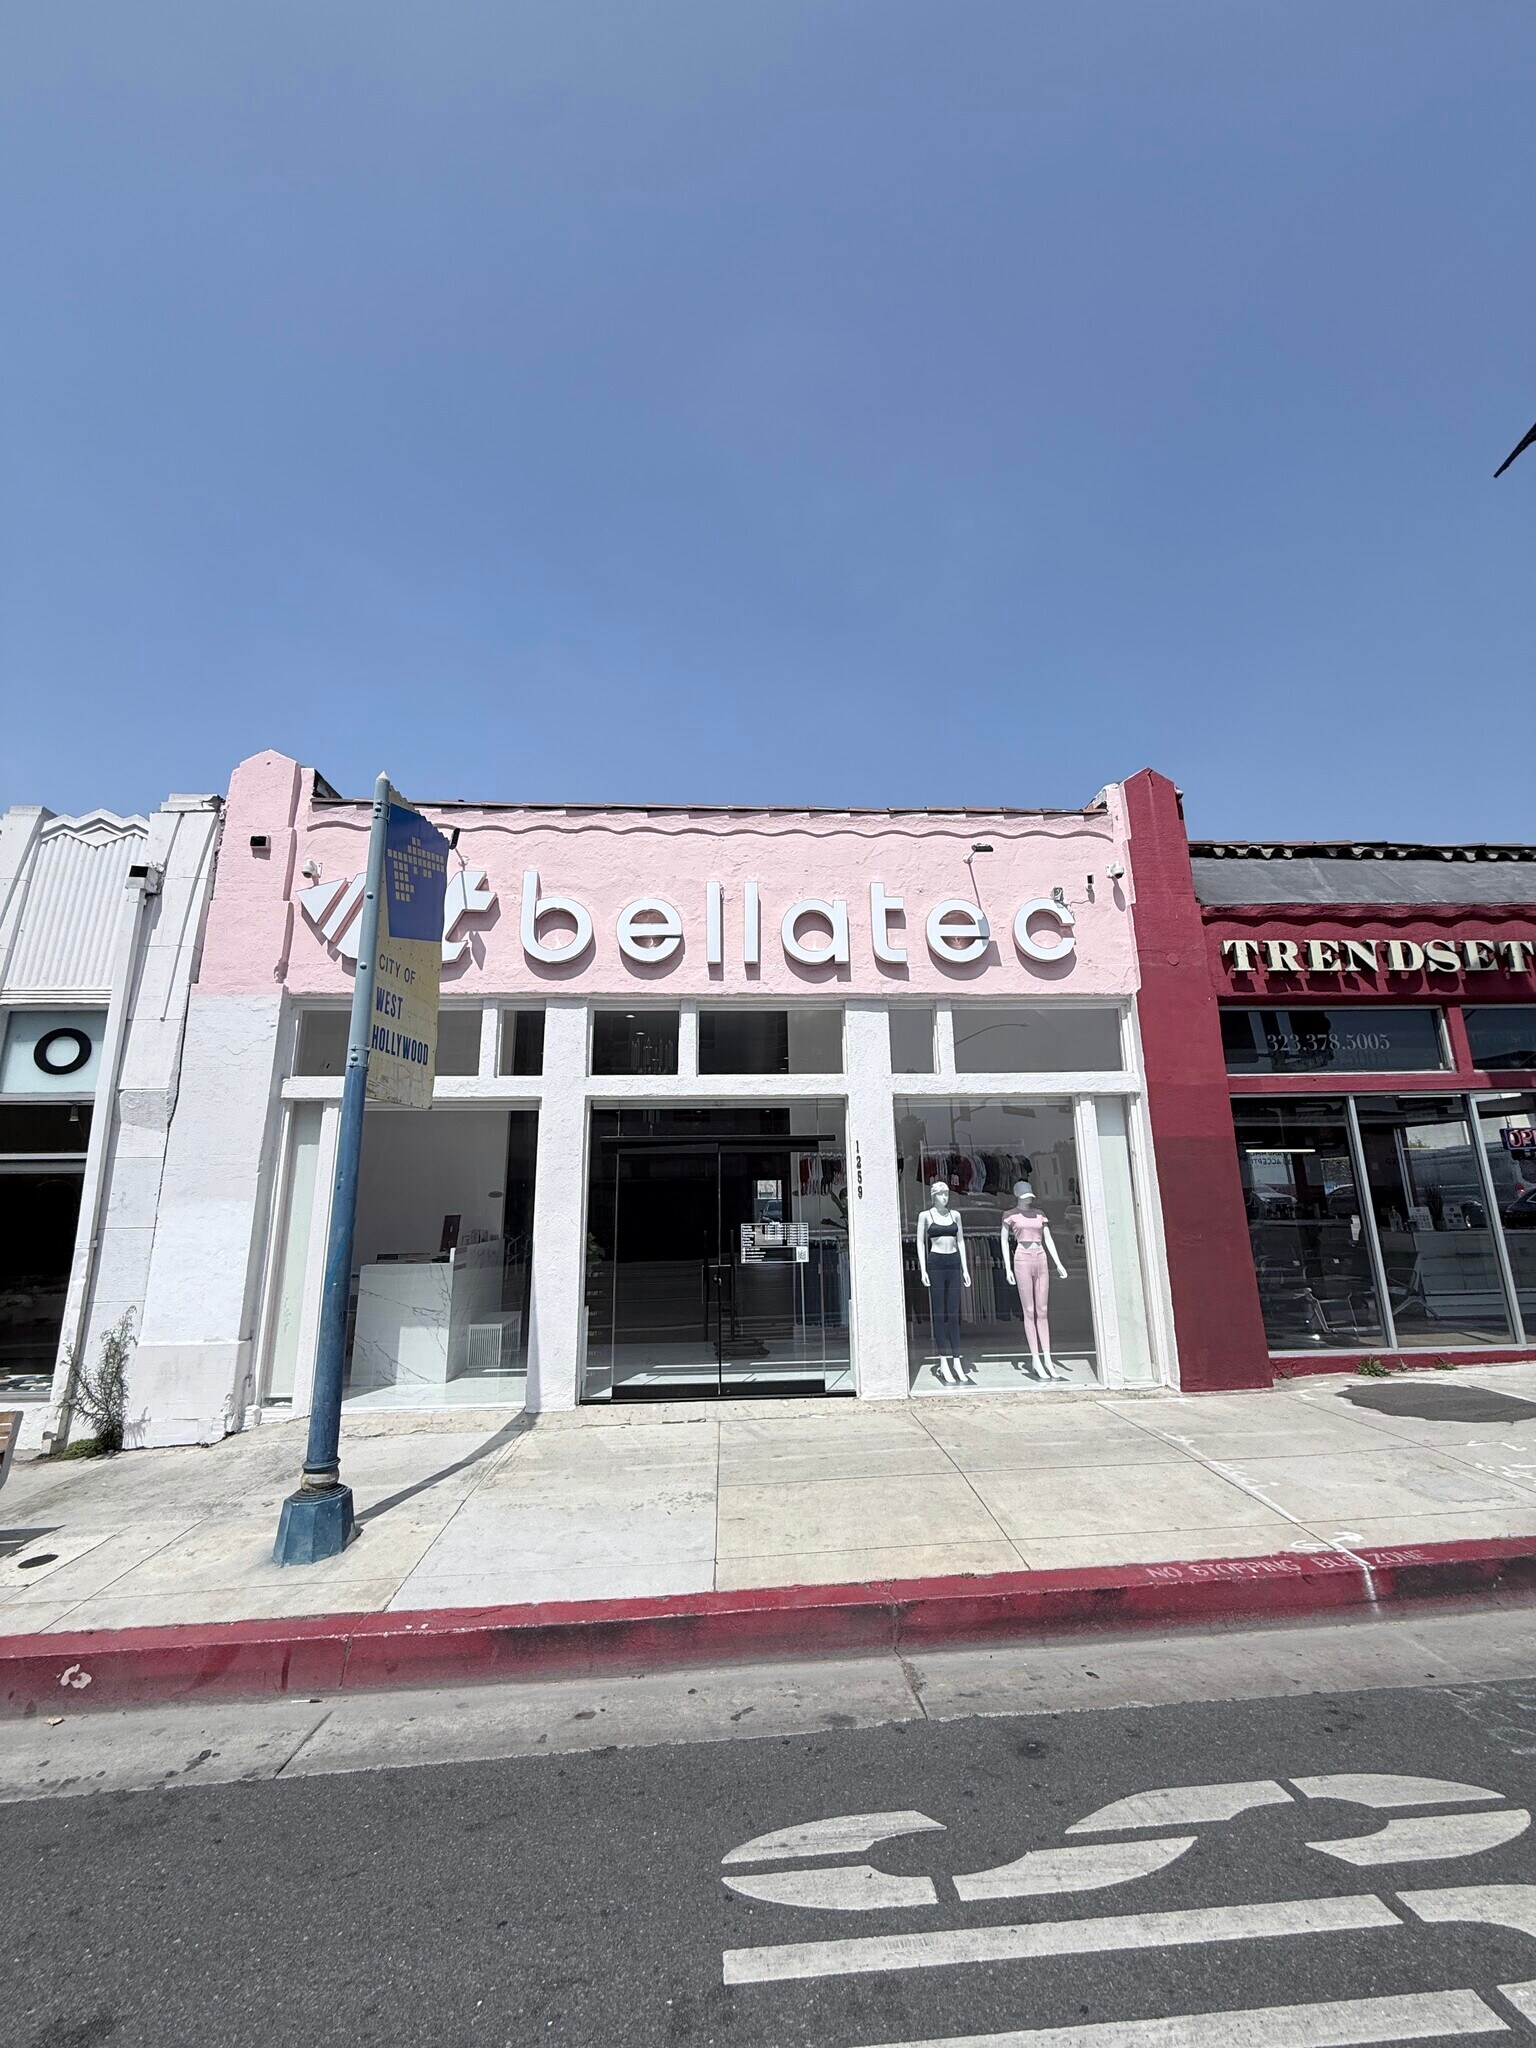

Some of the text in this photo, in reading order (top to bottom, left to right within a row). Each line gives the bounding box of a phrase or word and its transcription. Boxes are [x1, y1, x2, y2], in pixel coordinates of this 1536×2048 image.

[519, 869, 1077, 964] bellatec
[378, 953, 416, 985] CITY OF
[1222, 939, 1535, 973] TRENDSET
[376, 986, 403, 1020] WEST
[371, 1024, 429, 1066] HOLLYWOOD
[1267, 1033, 1390, 1051] 323.378.5005
[855, 1139, 863, 1200] 1259
[1146, 1549, 1433, 1579] NO STOPPING BUS ZONE
